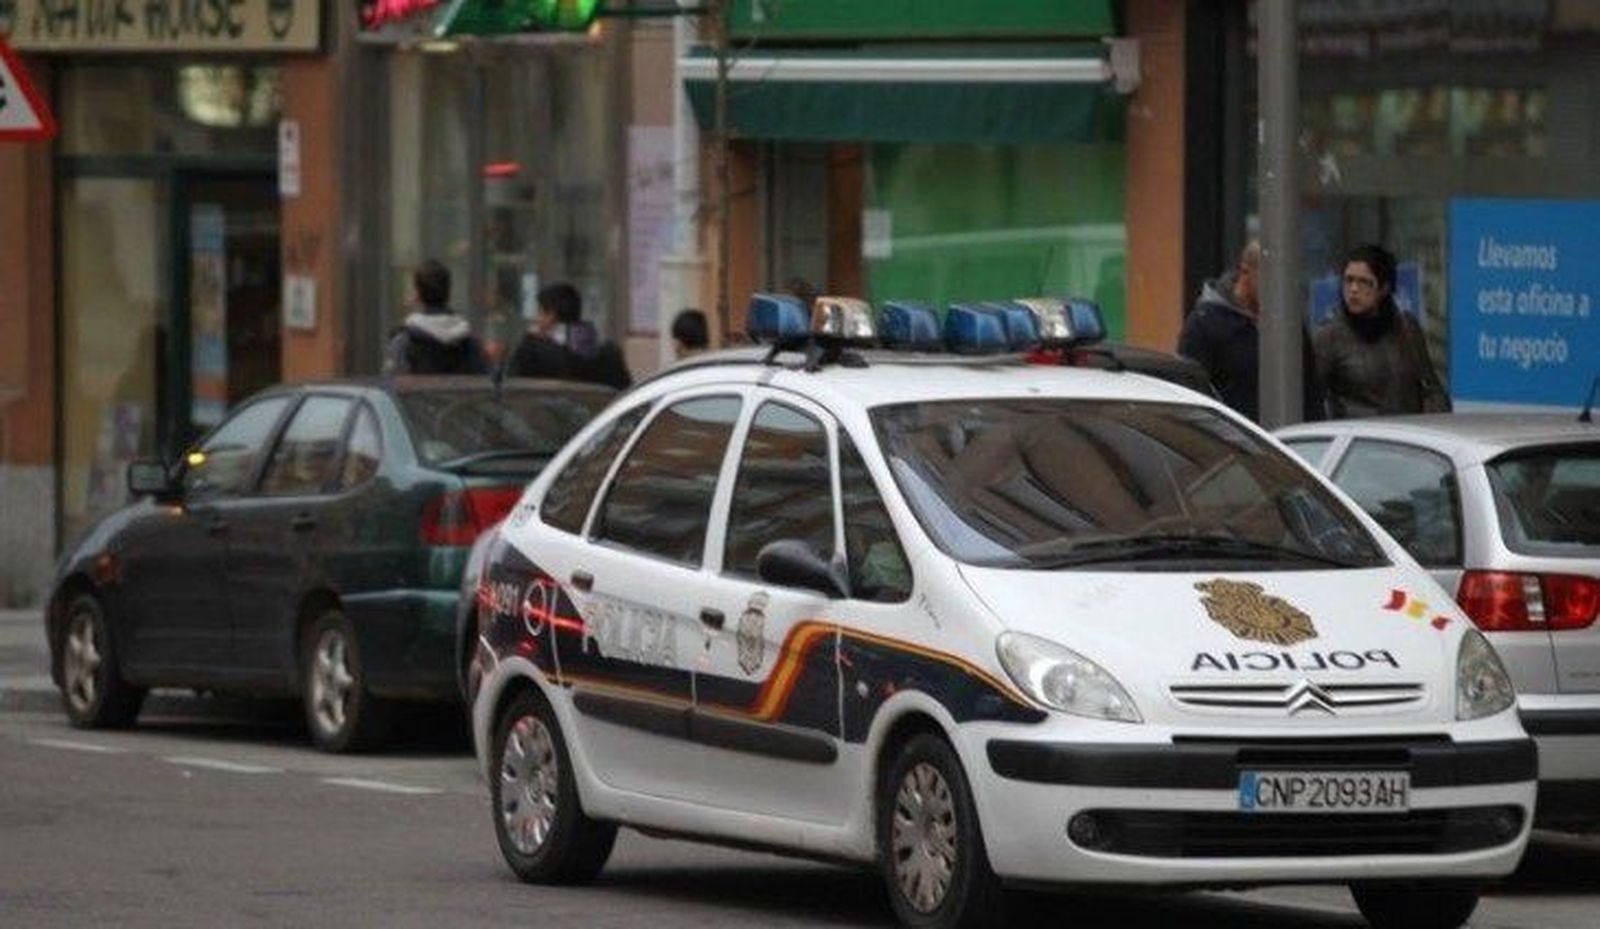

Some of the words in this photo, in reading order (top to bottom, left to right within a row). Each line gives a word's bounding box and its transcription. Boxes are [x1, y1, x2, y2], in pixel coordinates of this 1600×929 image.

[1478, 237, 1557, 271] Llevamos
[1478, 288, 1513, 315] esta
[1517, 282, 1574, 317] oficina
[1579, 293, 1590, 317] a
[1480, 333, 1497, 359] tu
[1501, 332, 1568, 371] negocio
